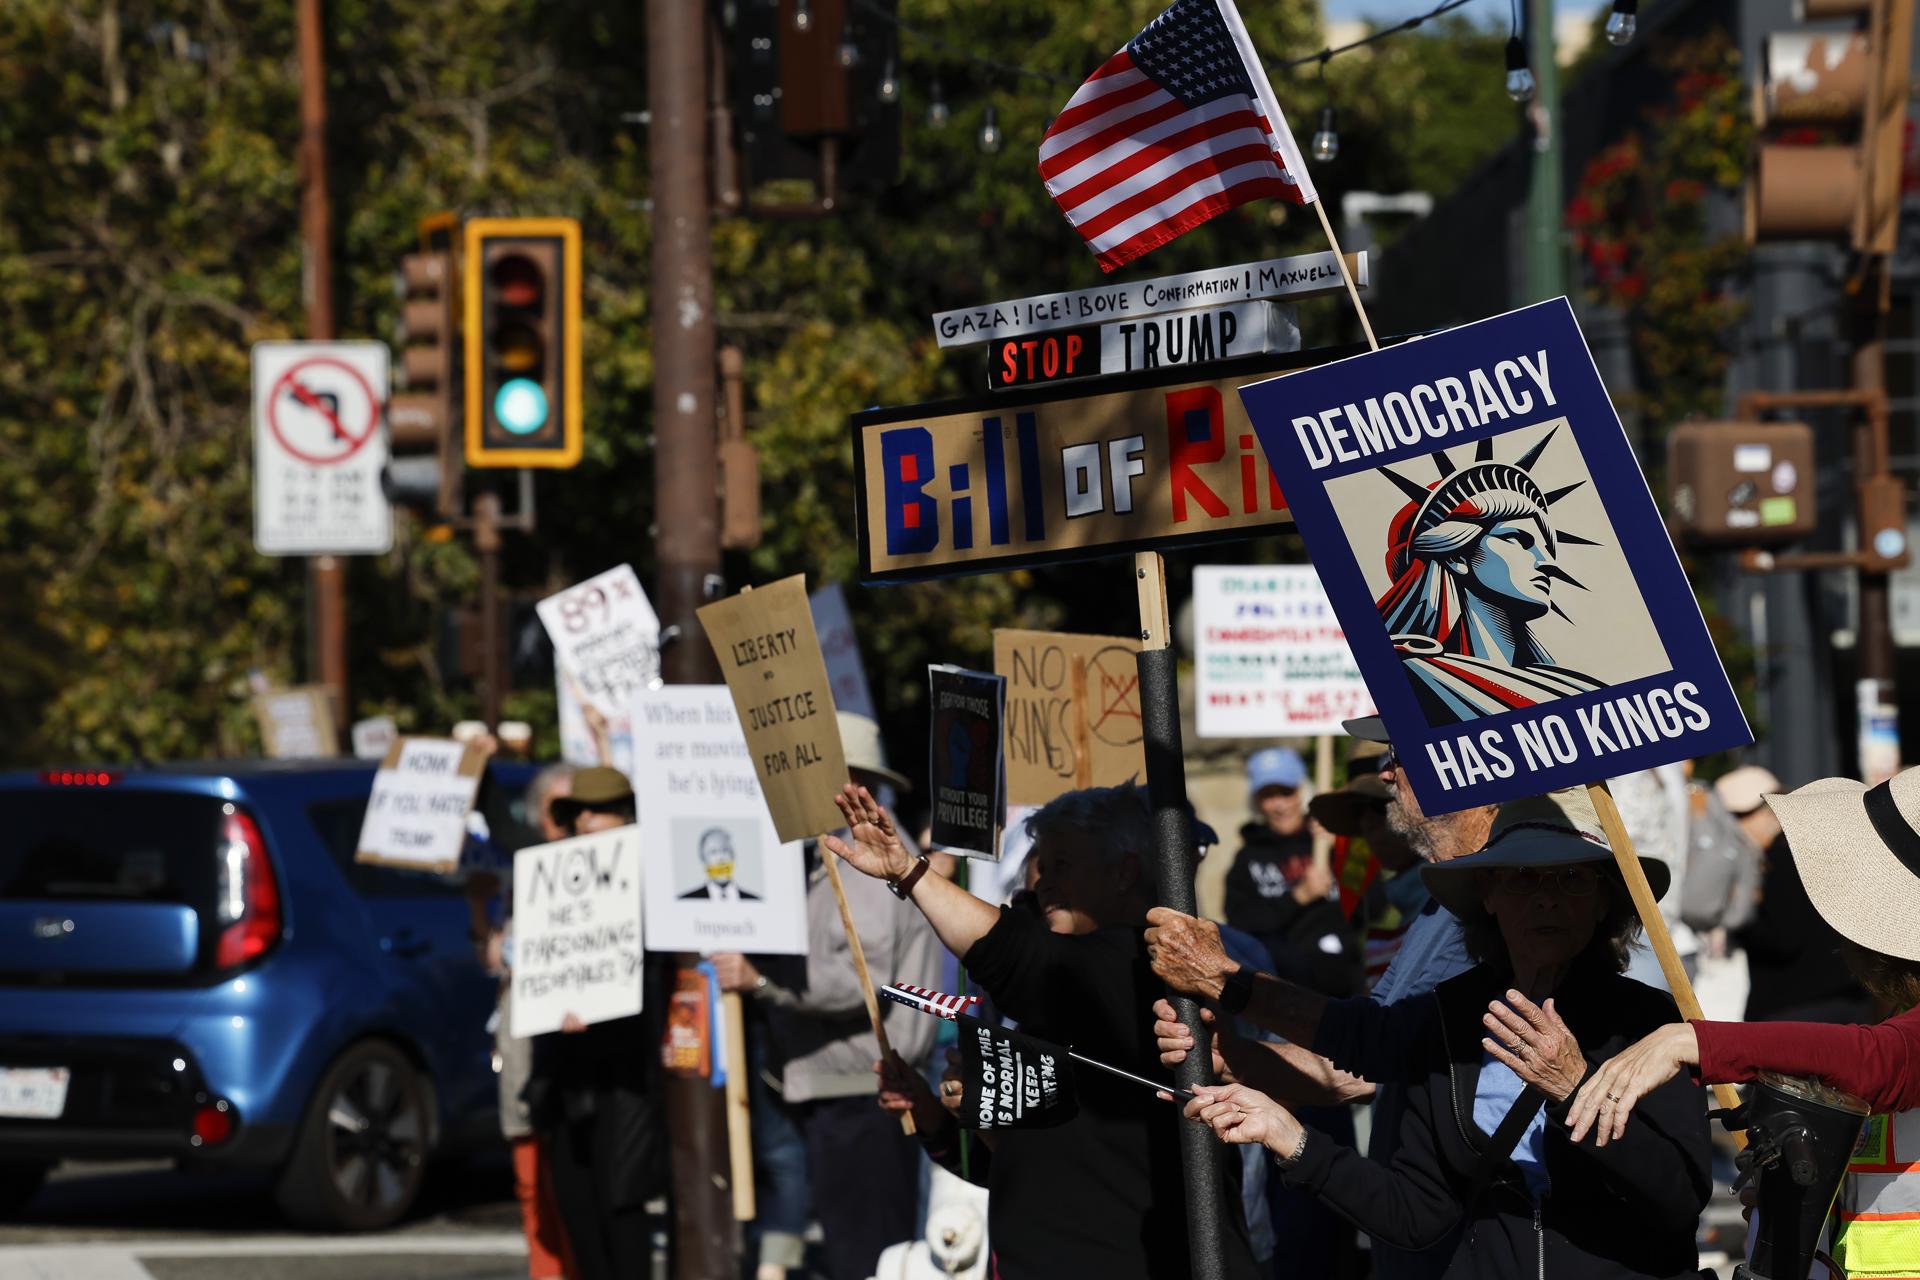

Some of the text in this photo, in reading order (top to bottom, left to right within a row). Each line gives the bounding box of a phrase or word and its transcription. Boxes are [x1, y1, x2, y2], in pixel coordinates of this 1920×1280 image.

[1079, 292, 1129, 317] BOVE
[1259, 264, 1337, 292] MAXWELL
[1002, 311, 1237, 383] STOP TRUMP
[1291, 350, 1558, 470] DEMOCRACY
[880, 411, 1046, 556] Bill
[1061, 435, 1145, 519] OF
[732, 628, 797, 667] LIBERTY
[1012, 645, 1066, 691] NO
[749, 691, 817, 731] JUSTICE
[691, 738, 747, 760] movin
[1006, 698, 1076, 778] KINGS
[1424, 681, 1711, 791] HAS NO KINGS
[763, 742, 822, 776] FOR ALL
[937, 801, 988, 830] PRIVILEGE
[977, 1027, 993, 1058] THIS
[983, 1059, 995, 1084] OF
[996, 1039, 1014, 1110] NORMAL
[1025, 1065, 1041, 1109] KEEP
